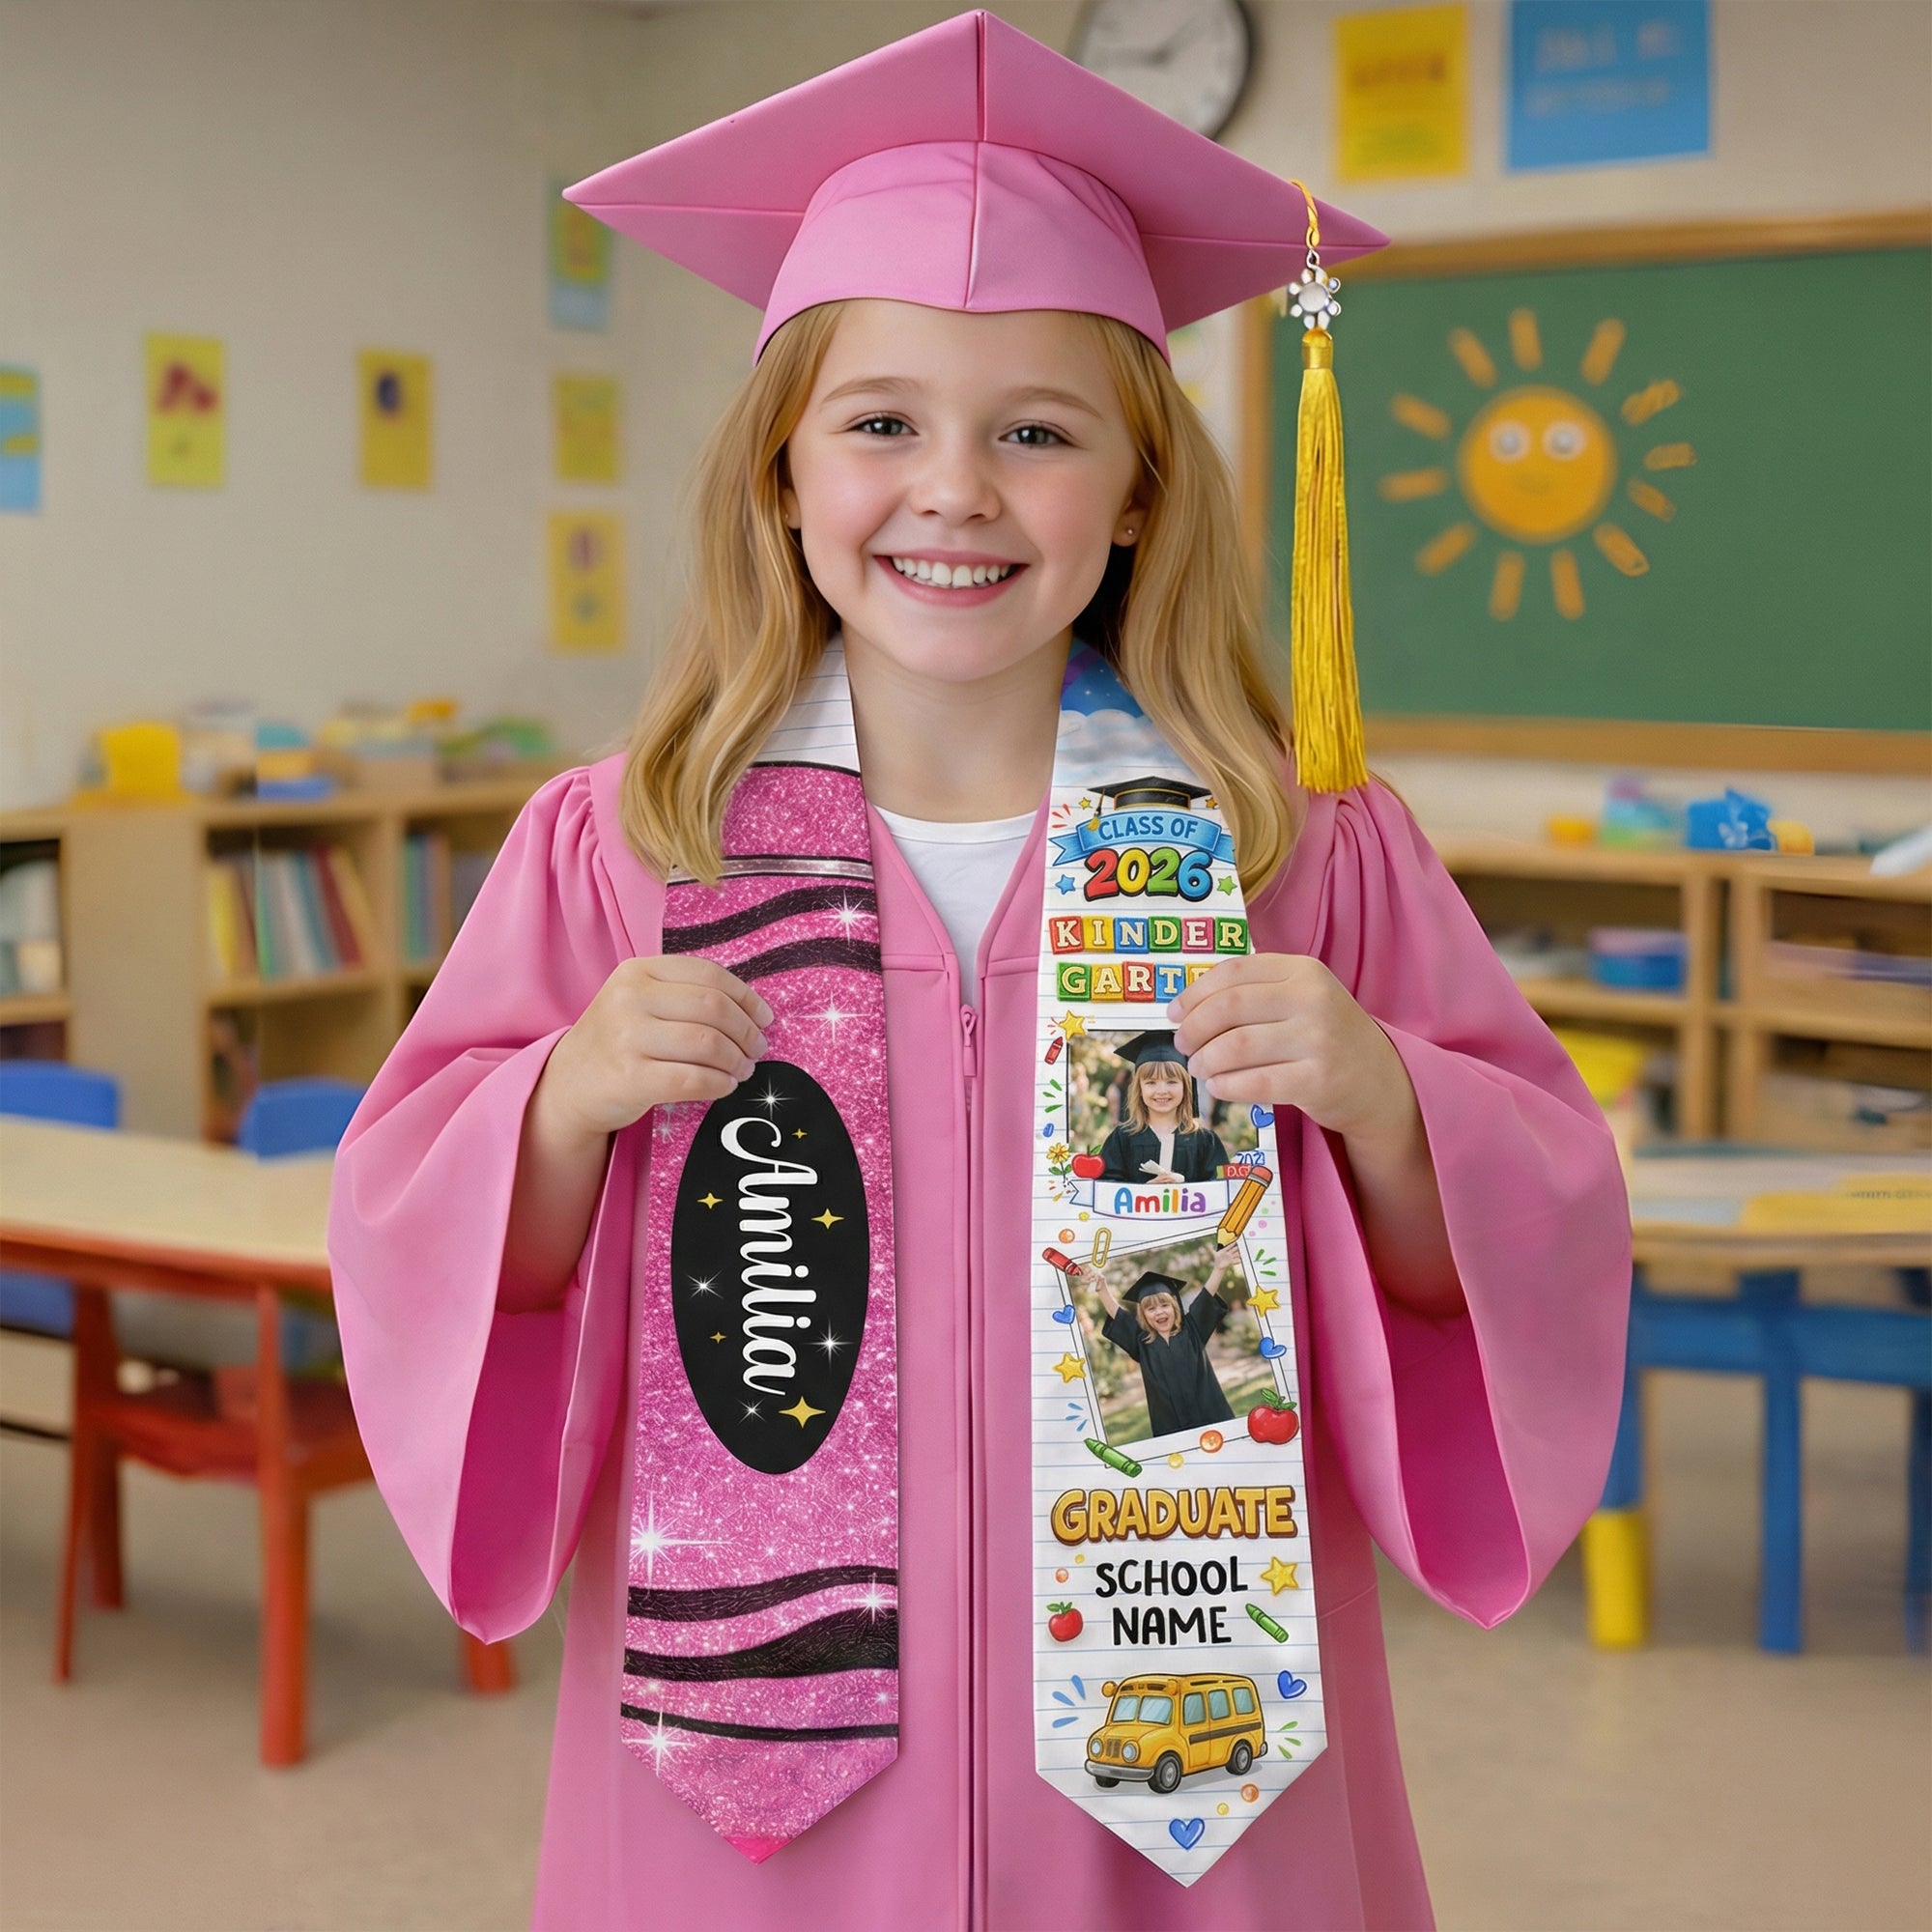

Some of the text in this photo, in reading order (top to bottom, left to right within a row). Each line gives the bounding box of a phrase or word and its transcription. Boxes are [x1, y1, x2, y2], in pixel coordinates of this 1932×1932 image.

[1098, 816, 1199, 840] CLASS OF
[1084, 847, 1213, 902] 2026
[1056, 920, 1245, 948] KINDER
[1114, 1187, 1207, 1214] Amilia
[720, 1117, 818, 1396] Amilia
[1050, 1485, 1299, 1546] GRADUATE
[1094, 1555, 1249, 1598] SCHOOL
[1113, 1605, 1233, 1646] NAME
